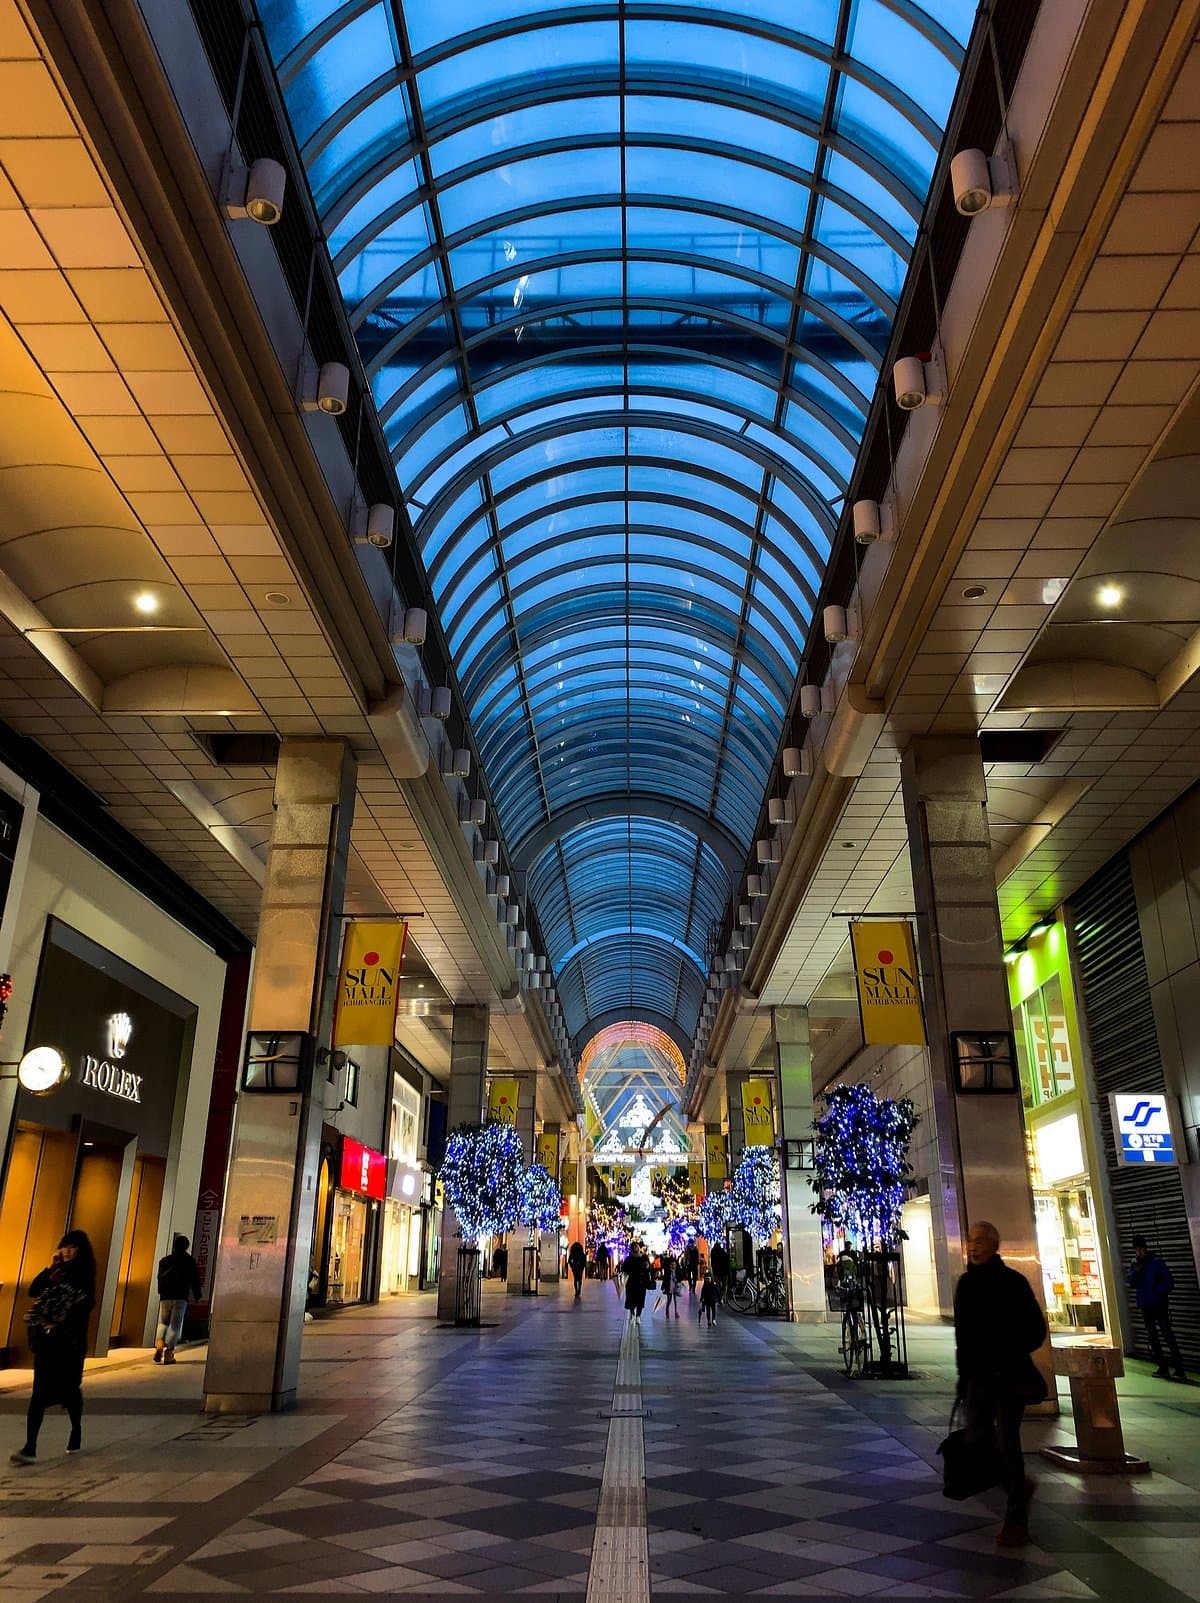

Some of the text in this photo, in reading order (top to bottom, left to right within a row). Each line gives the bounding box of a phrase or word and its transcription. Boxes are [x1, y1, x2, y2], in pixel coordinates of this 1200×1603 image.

[343, 967, 396, 987] SUN
[863, 967, 915, 986] SUN
[344, 986, 393, 1000] MALL
[866, 986, 917, 998] MALL
[83, 1055, 143, 1104] ROLEX
[491, 1105, 514, 1115] SUN
[745, 1105, 771, 1115] SUN
